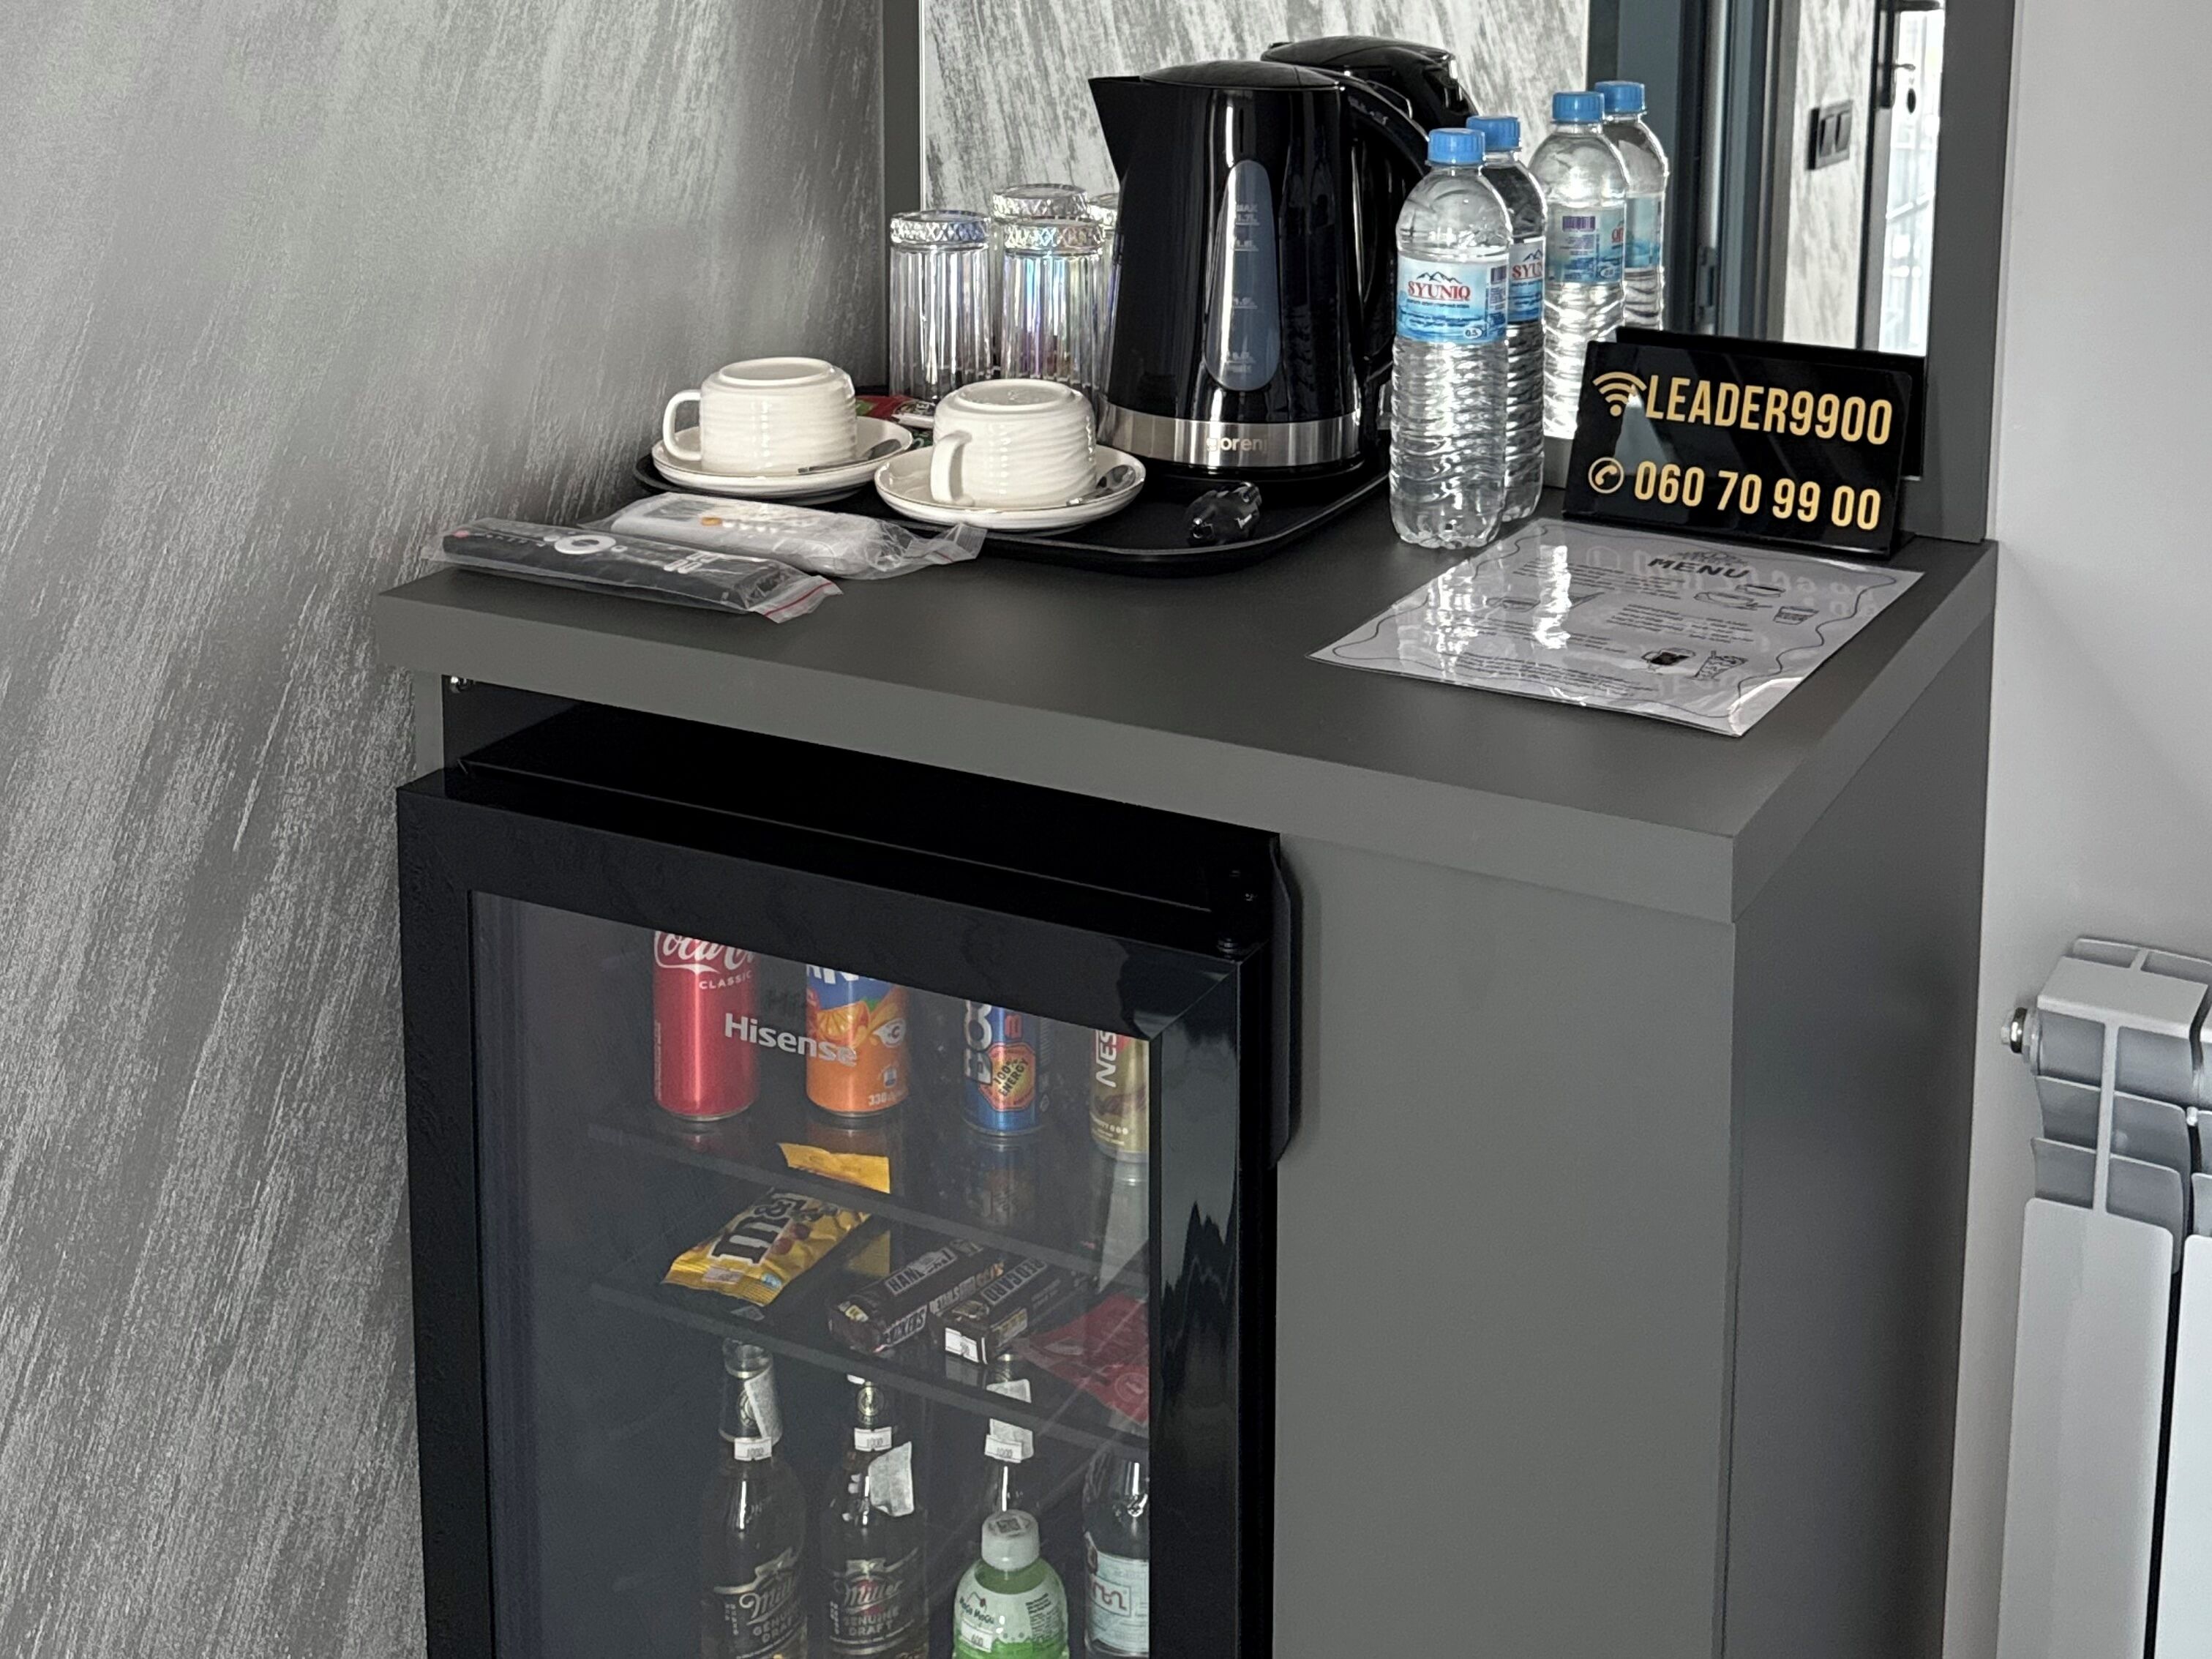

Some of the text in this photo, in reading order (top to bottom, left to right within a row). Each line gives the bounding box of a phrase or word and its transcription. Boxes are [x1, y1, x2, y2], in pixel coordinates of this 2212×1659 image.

[1408, 280, 1471, 301] SYUNIQ
[1646, 375, 1893, 445] LEADER9900
[1635, 460, 1881, 531] 060 70 99 00
[1648, 558, 1750, 578] MENU
[698, 970, 752, 989] CLASSIC
[724, 1013, 858, 1068] Hisense
[993, 1058, 1020, 1085] 100%
[999, 1057, 1030, 1096] ENERGY
